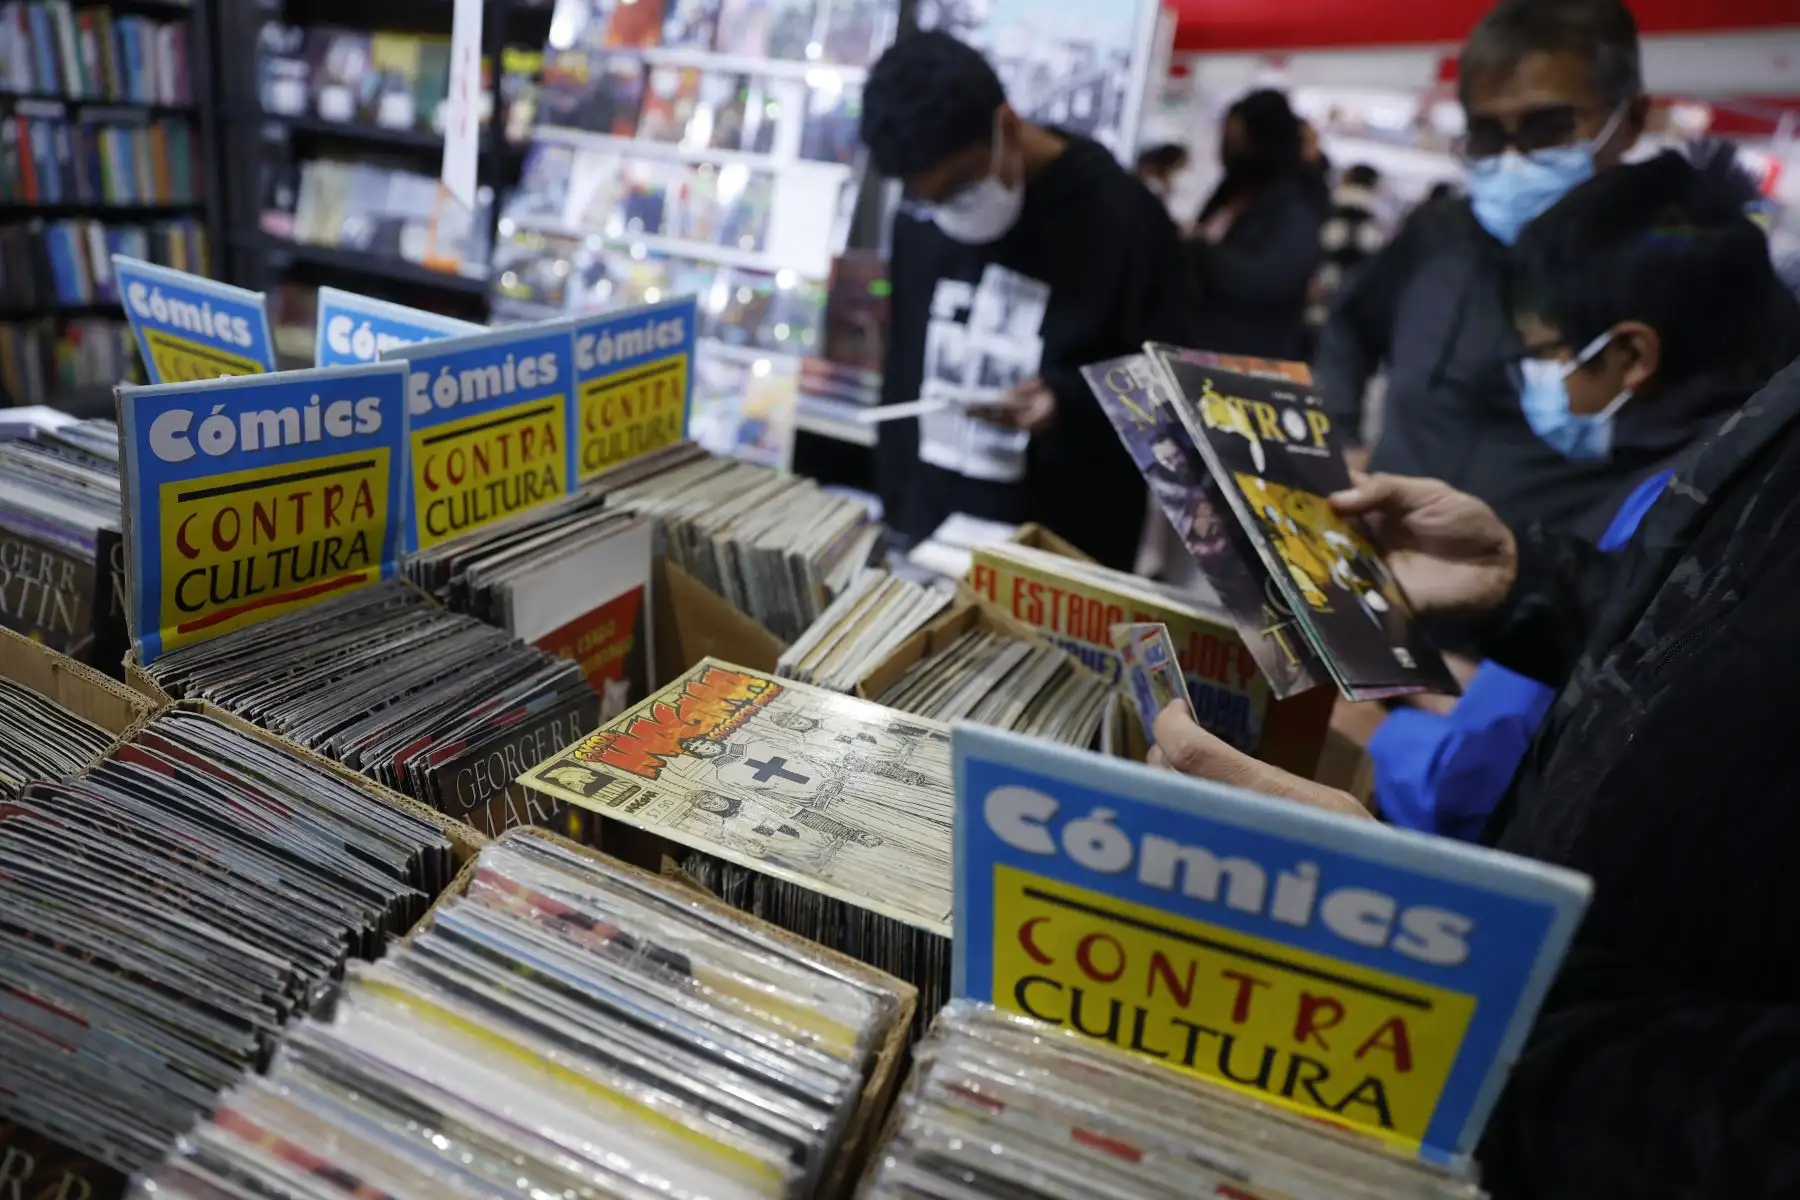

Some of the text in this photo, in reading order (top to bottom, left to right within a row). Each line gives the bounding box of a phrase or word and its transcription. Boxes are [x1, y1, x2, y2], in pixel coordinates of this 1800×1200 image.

[127, 281, 253, 348] Cómics
[576, 316, 685, 370] Cómics
[409, 351, 559, 415] Cómics
[584, 377, 682, 434] CONTRA
[149, 394, 382, 463] Cómics
[422, 421, 558, 493] CONTRA
[582, 411, 679, 472] CULTURA
[176, 478, 375, 560] CONTRA
[425, 465, 560, 538] CULTURA
[174, 529, 370, 613] CULTURA
[983, 784, 1475, 967] Cómics
[1018, 915, 1415, 1074] CONTRA
[1013, 974, 1396, 1130] CULTURA
